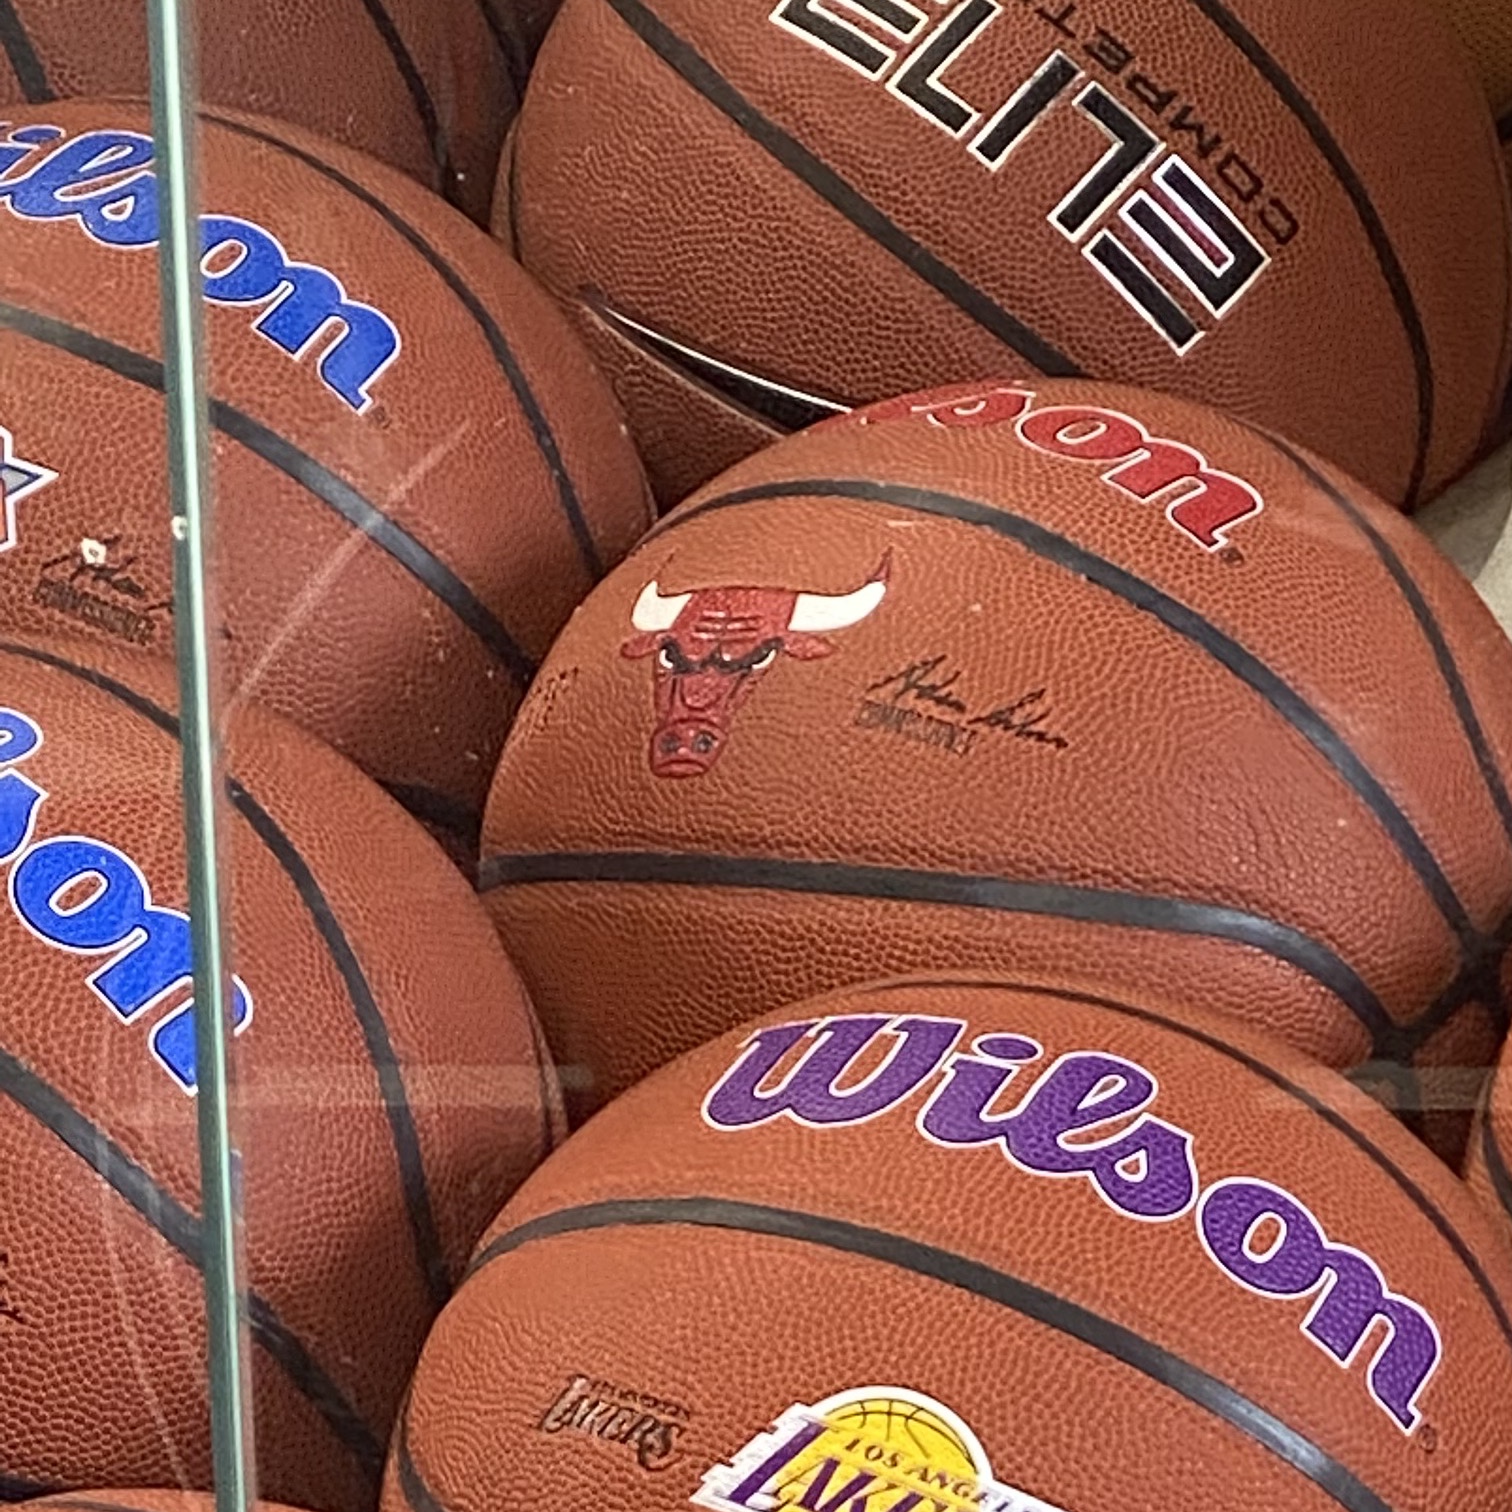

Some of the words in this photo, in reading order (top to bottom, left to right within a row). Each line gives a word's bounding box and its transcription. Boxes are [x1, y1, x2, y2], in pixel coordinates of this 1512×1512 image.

[0, 121, 402, 416] ilson
[701, 1012, 1442, 1436] Wilson
[843, 1437, 898, 1470] LOS
